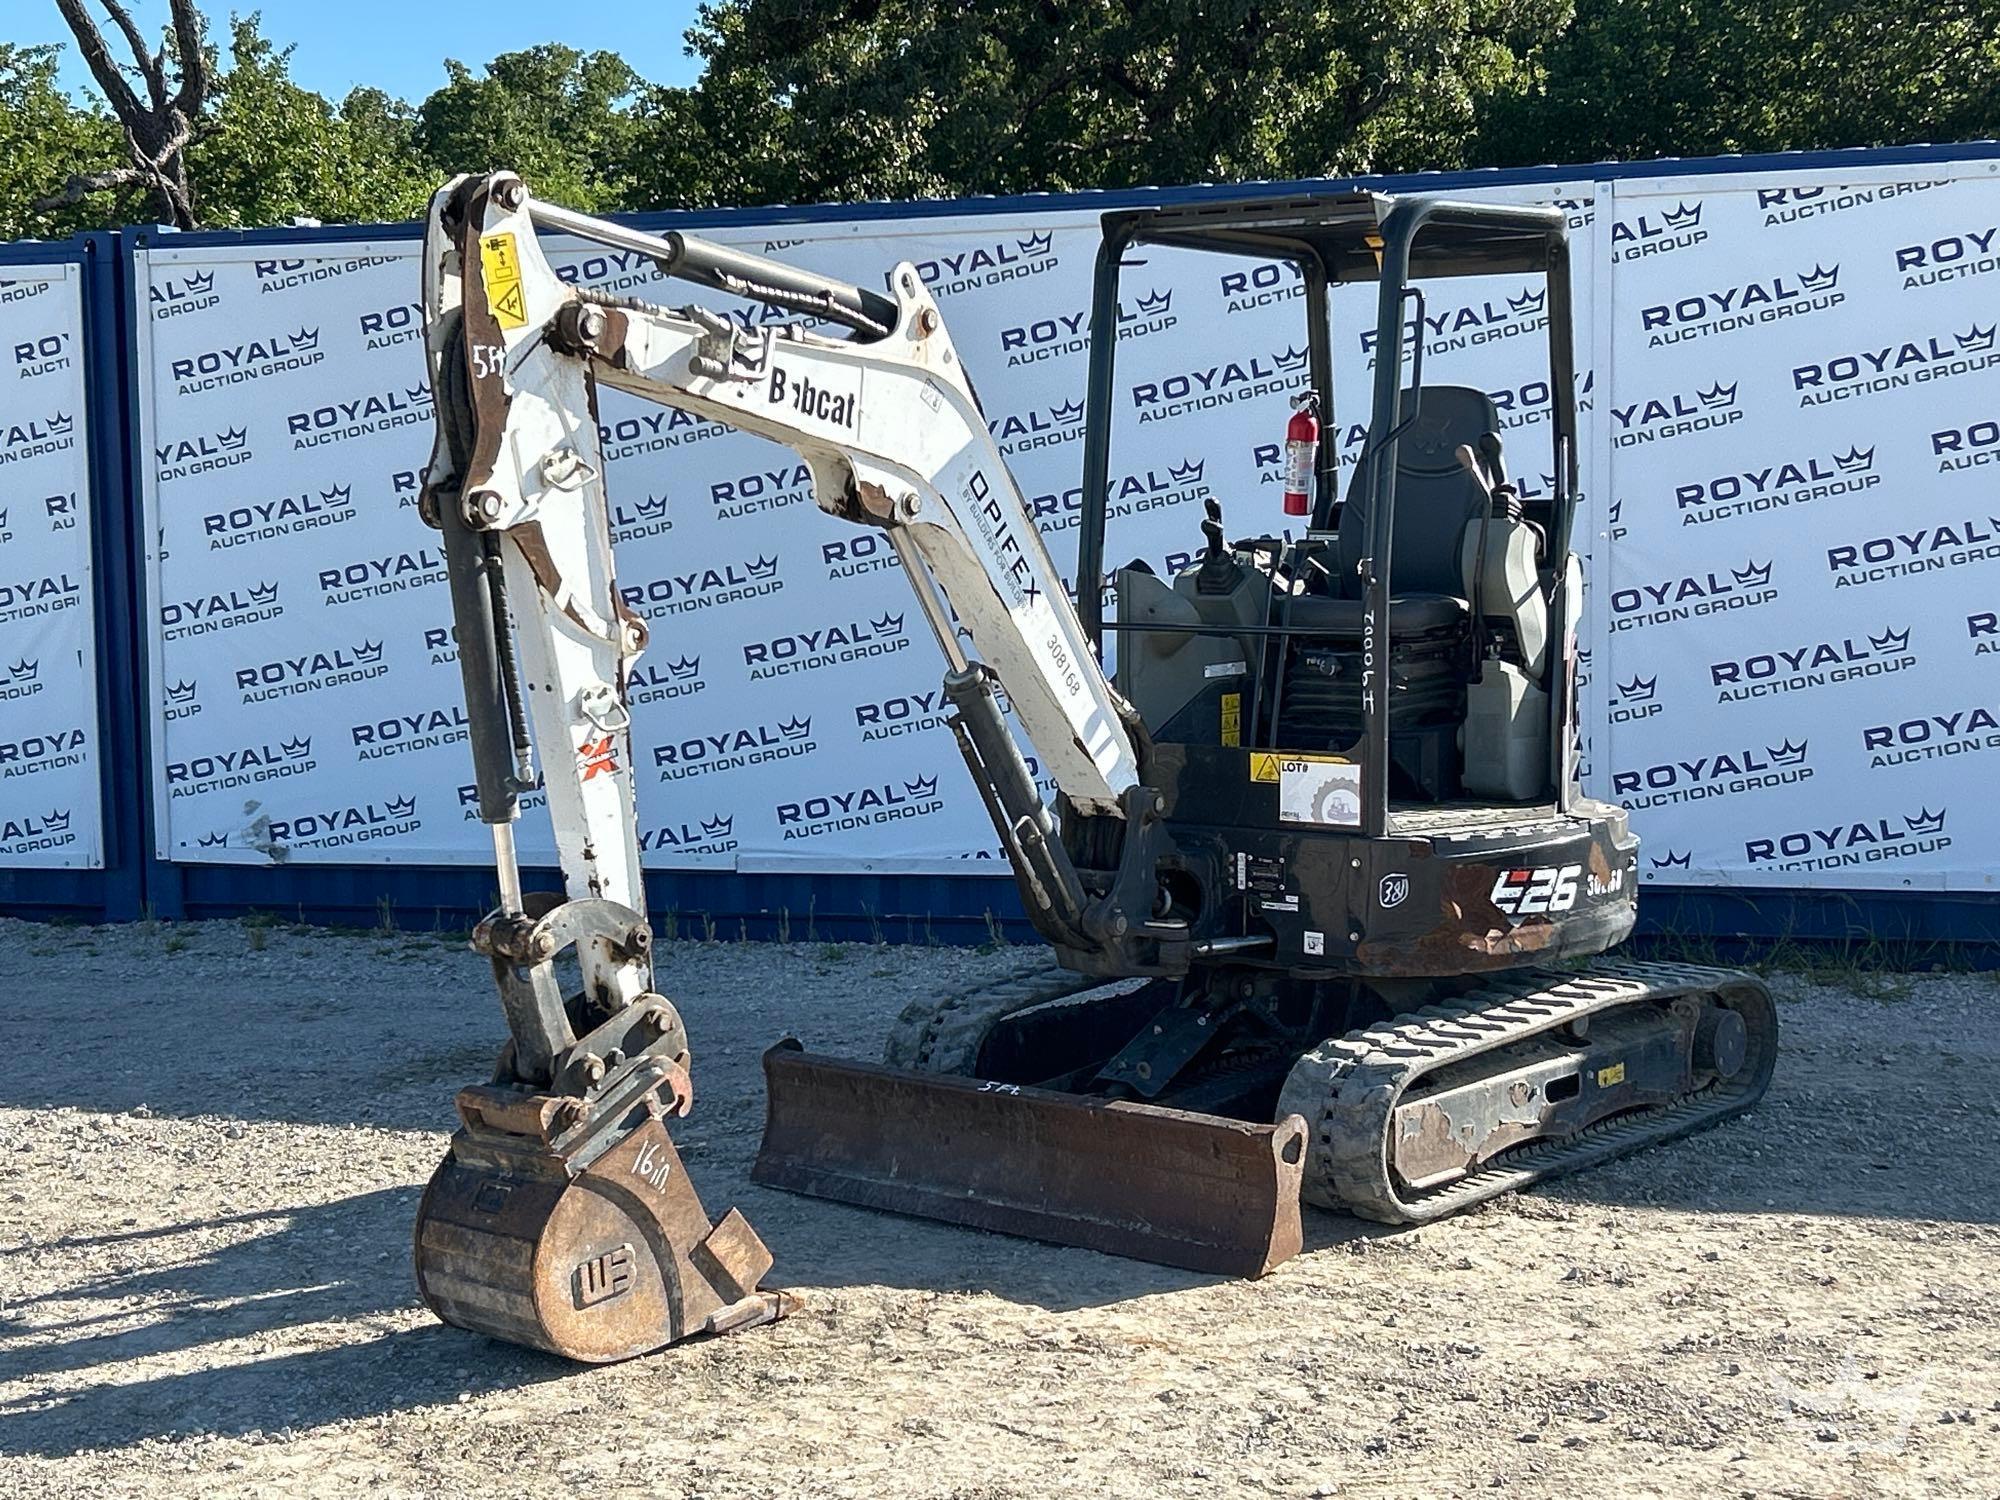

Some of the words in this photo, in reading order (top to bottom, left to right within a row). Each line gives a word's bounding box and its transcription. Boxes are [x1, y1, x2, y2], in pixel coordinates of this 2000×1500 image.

[1765, 190, 1873, 227] AUCTION
[1625, 231, 1708, 260] GROUP
[1896, 228, 1997, 272] ROY
[262, 265, 342, 294] AUCTION
[884, 244, 1019, 293] OYAL
[986, 258, 1058, 285] GROUP
[1220, 260, 1303, 298] ROY
[1903, 257, 2000, 290] AUCTIO
[1, 282, 49, 303] ROUP
[158, 296, 219, 319] GROUP
[1227, 285, 1306, 314] AUCTIO
[1641, 278, 1799, 331] ROYAL
[367, 329, 421, 350] AUCTI
[1001, 302, 1137, 351] ROYL
[1117, 316, 1178, 341] ROUP
[1649, 313, 1754, 348] AUCTION
[1760, 293, 1845, 322] GROUP
[20, 357, 70, 379] AUCTI
[172, 338, 290, 380] ROYAL
[179, 368, 258, 395] AUCTION
[261, 352, 324, 375] GROUP
[1793, 338, 1954, 390] ROYAL
[1132, 358, 1273, 407] ROYAL
[1800, 374, 1909, 408] AUCTION
[288, 392, 407, 435] ROYAL
[1139, 392, 1233, 424] AUCTION
[1610, 395, 1698, 428] YAL
[1660, 410, 1743, 438] GROUP
[156, 436, 218, 465] YAL
[294, 422, 375, 450] AUCTION
[190, 451, 252, 474] GROUP
[710, 465, 812, 504] ROYA
[1136, 486, 1209, 512] GROUP
[1676, 459, 1834, 509] ROYAL
[1683, 494, 1789, 526] AUCTION
[1794, 475, 1880, 505] GROUP
[204, 495, 322, 535] ROYAL
[718, 491, 803, 520] AUCTION
[211, 524, 289, 551] AUCTION
[293, 509, 356, 531] GROUP
[969, 470, 1041, 607] OPIFEX
[1827, 521, 1987, 571] ROYAL
[319, 550, 439, 590] ROYAL
[829, 555, 900, 580] AUCTIO
[1835, 556, 1945, 588] AUCTION
[1950, 545, 2000, 566] GRO
[0, 574, 79, 607] OYAL
[326, 580, 406, 606] AUCTION
[411, 571, 449, 586] GRO
[620, 566, 746, 607] ROYAL
[640, 596, 712, 620] UCTION
[716, 581, 783, 604] GROUP
[1611, 574, 1732, 613] OYAL
[1694, 590, 1777, 616] GROUP
[0, 602, 48, 623] CTION
[160, 592, 250, 625] OYAL
[165, 621, 218, 641] CTION
[222, 607, 283, 628] GROUP
[744, 623, 872, 665] ROYAL
[750, 654, 836, 681] AUCTION
[840, 639, 909, 662] GROUP
[1711, 640, 1870, 686] ROYAL
[236, 650, 354, 689] ROYAL
[243, 679, 321, 704] AUCTION
[325, 665, 388, 687] GROUP
[1046, 634, 1080, 697] 308168
[1718, 673, 1825, 704] AUCTION
[1830, 657, 1916, 682] GROUP
[0, 683, 43, 701] ROUP
[639, 681, 705, 704] GROUP
[165, 704, 202, 720] OUP
[352, 707, 470, 746] ROYAL
[1609, 704, 1662, 724] OUP
[1864, 709, 1999, 751] ROYA
[0, 729, 85, 764] ROYA
[168, 745, 282, 783] ROYAL
[359, 736, 439, 761] AUCTION
[653, 726, 780, 767] ROYAL
[660, 756, 745, 782] AUCTION
[749, 742, 816, 764] GROUP
[1871, 738, 1980, 768] AUCTION
[4, 754, 79, 778] AUCTION
[172, 774, 250, 798] AUCTION
[254, 761, 316, 782] GROUP
[1613, 751, 1768, 795] ROYAL
[777, 785, 905, 825] ROYAL
[1621, 783, 1725, 811] AUCTION
[1729, 768, 1813, 793] GROUP
[267, 805, 386, 843] ROYAL
[362, 820, 421, 842] GROUP
[639, 824, 702, 851] YAL
[784, 815, 870, 840] AUCTION
[874, 801, 943, 823] GROUP
[16, 834, 75, 853] GROUP
[1745, 820, 1905, 863] ROYAL
[1865, 837, 1951, 862] GROUP
[1490, 864, 1582, 914] E26
